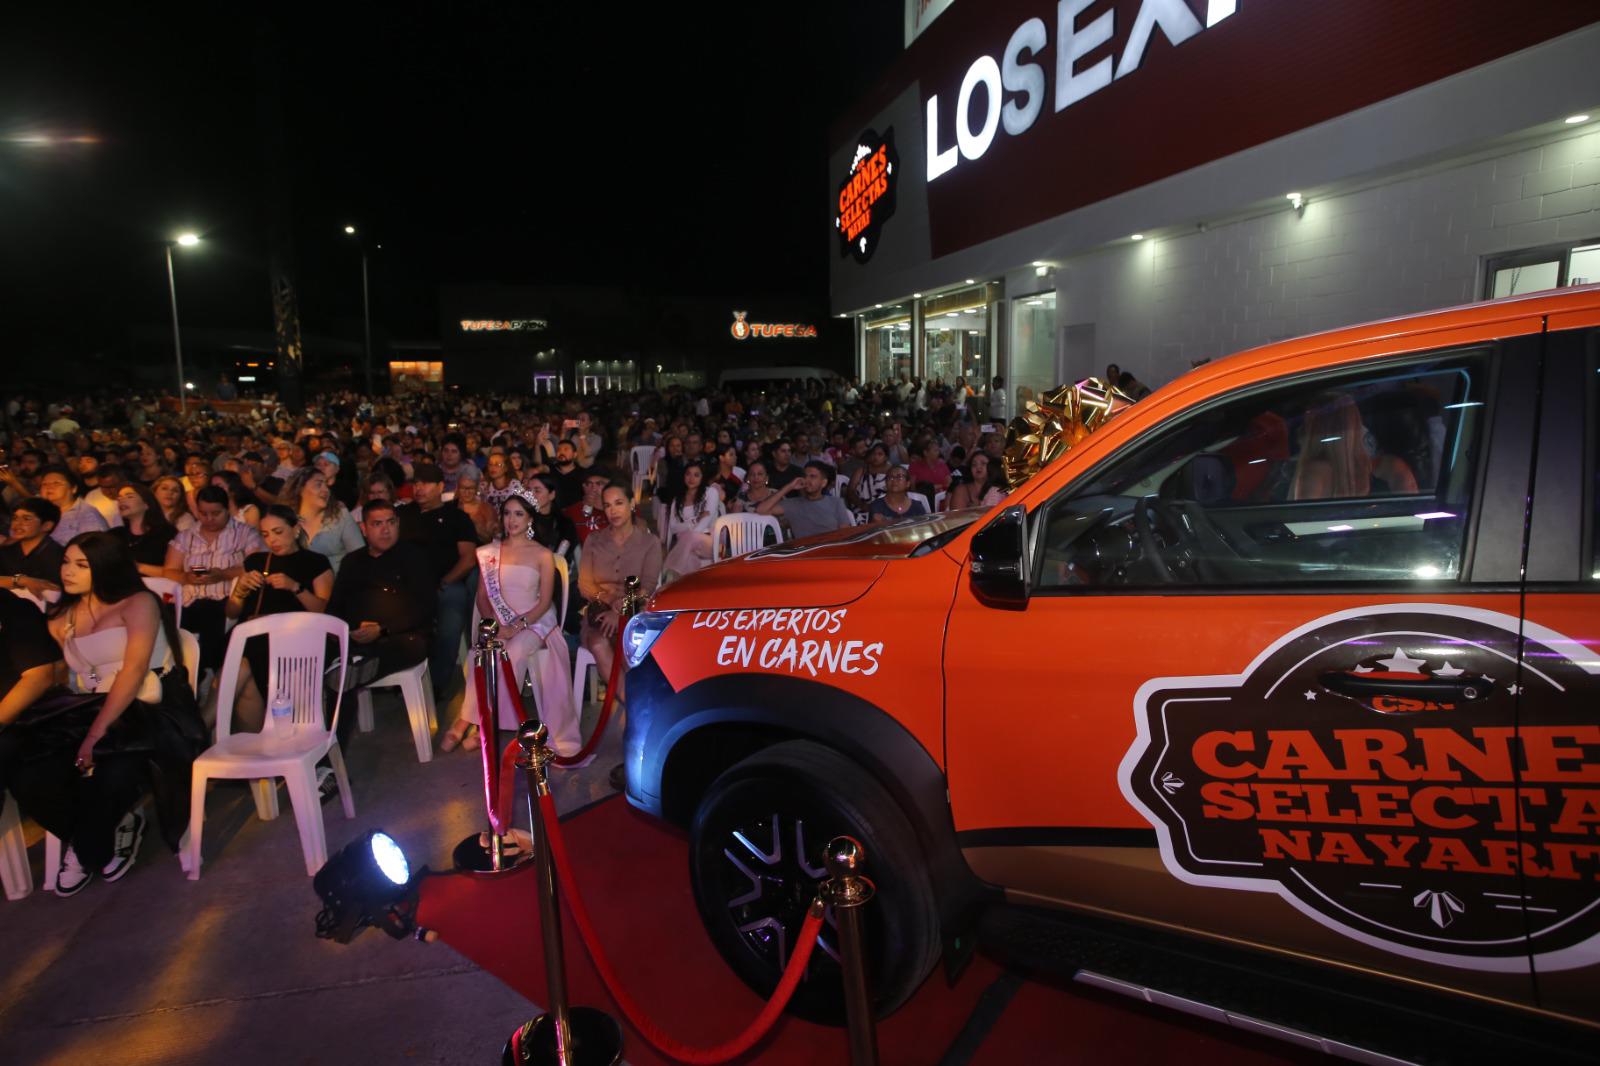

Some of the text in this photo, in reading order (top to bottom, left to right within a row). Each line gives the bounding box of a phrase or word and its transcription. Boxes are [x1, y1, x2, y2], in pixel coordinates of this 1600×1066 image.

[927, 17, 1047, 182] LOS
[839, 144, 887, 213] CARNES
[840, 171, 888, 233] SELECTAS
[750, 324, 817, 337] TUFESA
[692, 608, 848, 636] LOS EXPERTOS
[716, 635, 884, 677] EN CARNES
